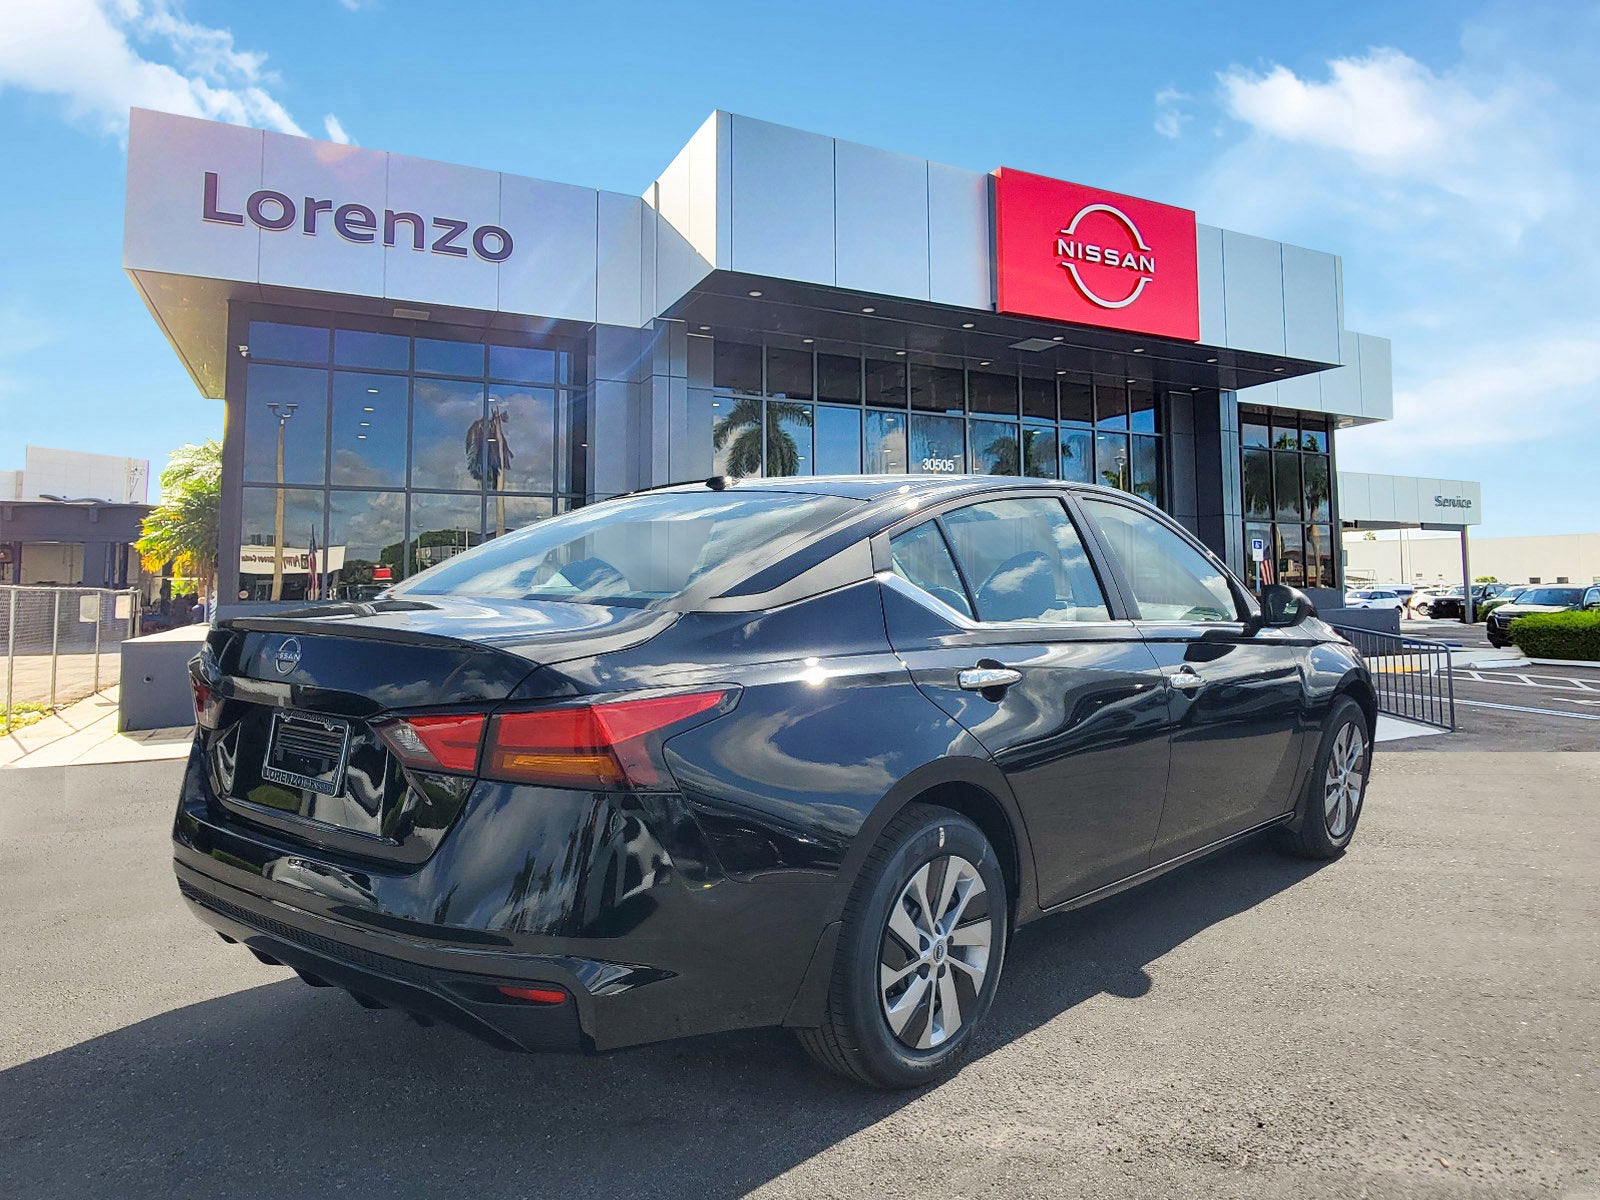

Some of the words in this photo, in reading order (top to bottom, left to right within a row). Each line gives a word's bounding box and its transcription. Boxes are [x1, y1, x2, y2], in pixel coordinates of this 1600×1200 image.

[202, 171, 514, 262] Lorenzo
[1057, 238, 1155, 273] NISSAN
[922, 458, 954, 471] 30505
[1434, 495, 1472, 508] Service
[275, 651, 301, 662] SSAN
[263, 767, 302, 786] LORENZO
